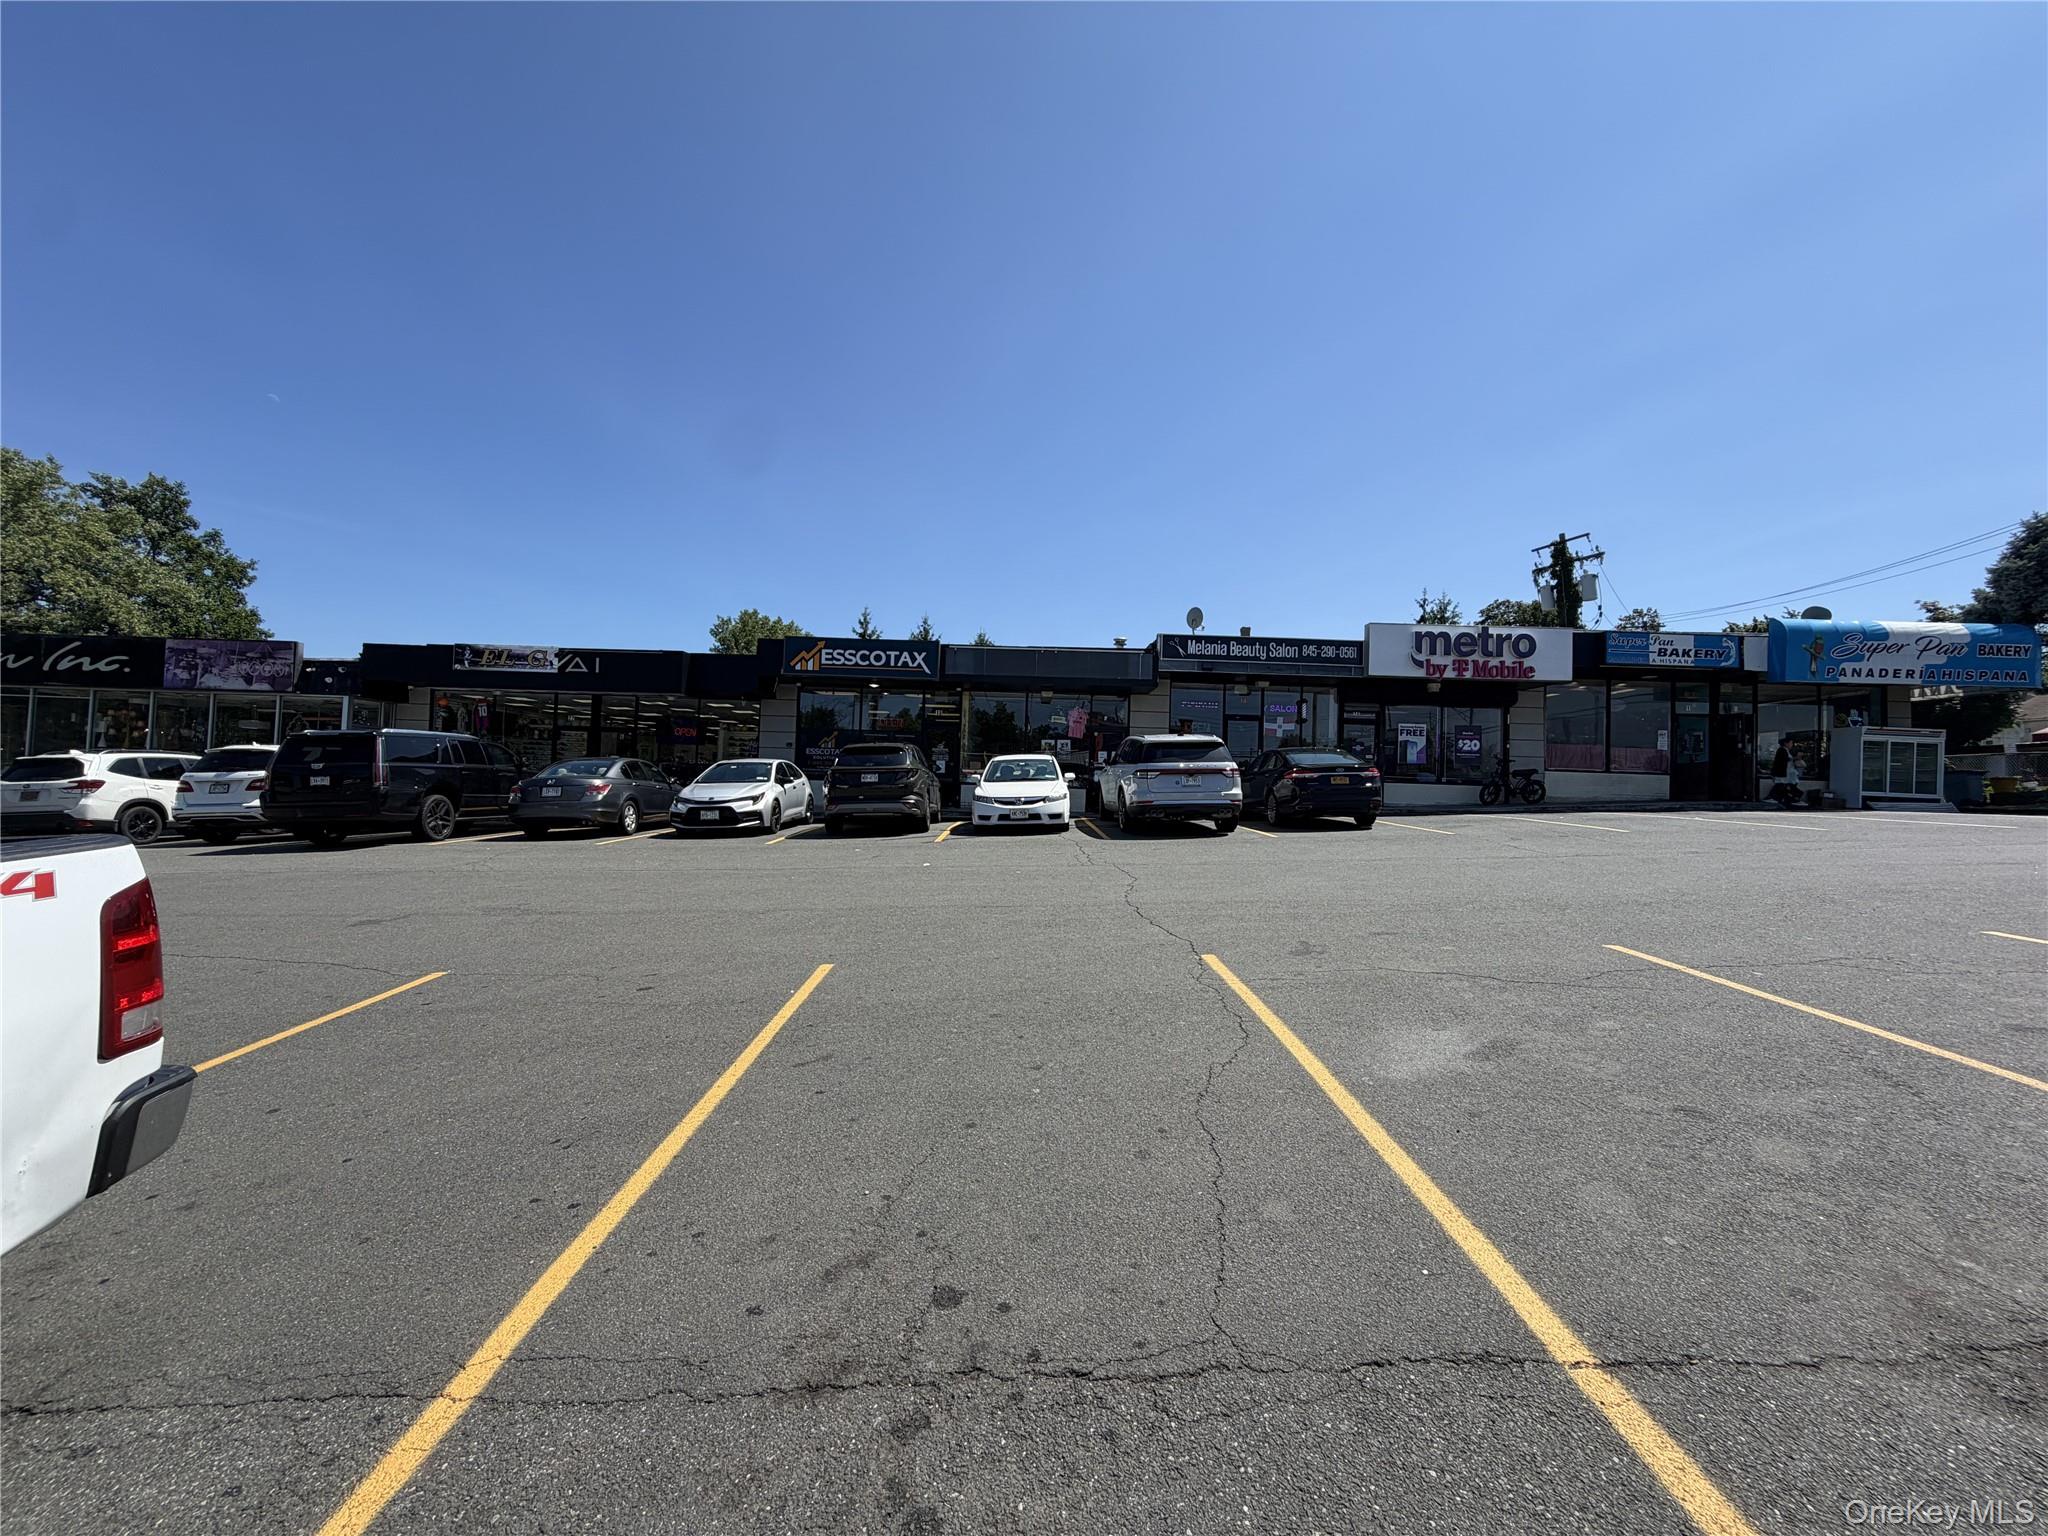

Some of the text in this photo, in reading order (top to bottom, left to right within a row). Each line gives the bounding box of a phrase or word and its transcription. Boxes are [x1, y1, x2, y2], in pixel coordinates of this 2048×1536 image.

[1187, 639, 1358, 659] Melania Beauty Salon 845-290-0561
[1414, 627, 1536, 658] metro
[1610, 633, 1675, 648] Super Pan
[1831, 633, 2032, 663] Super Pan BAKERY
[42, 641, 131, 672] Inc.
[821, 649, 932, 674] ESSCOTAX
[1657, 648, 1728, 659] BAKERY
[1426, 659, 1448, 678] by
[1472, 660, 1535, 679] Mobile
[1941, 669, 2030, 683] HISPANA
[1400, 729, 1425, 737] FREE
[805, 747, 841, 756] ESSCOTA
[1456, 739, 1481, 752] $20
